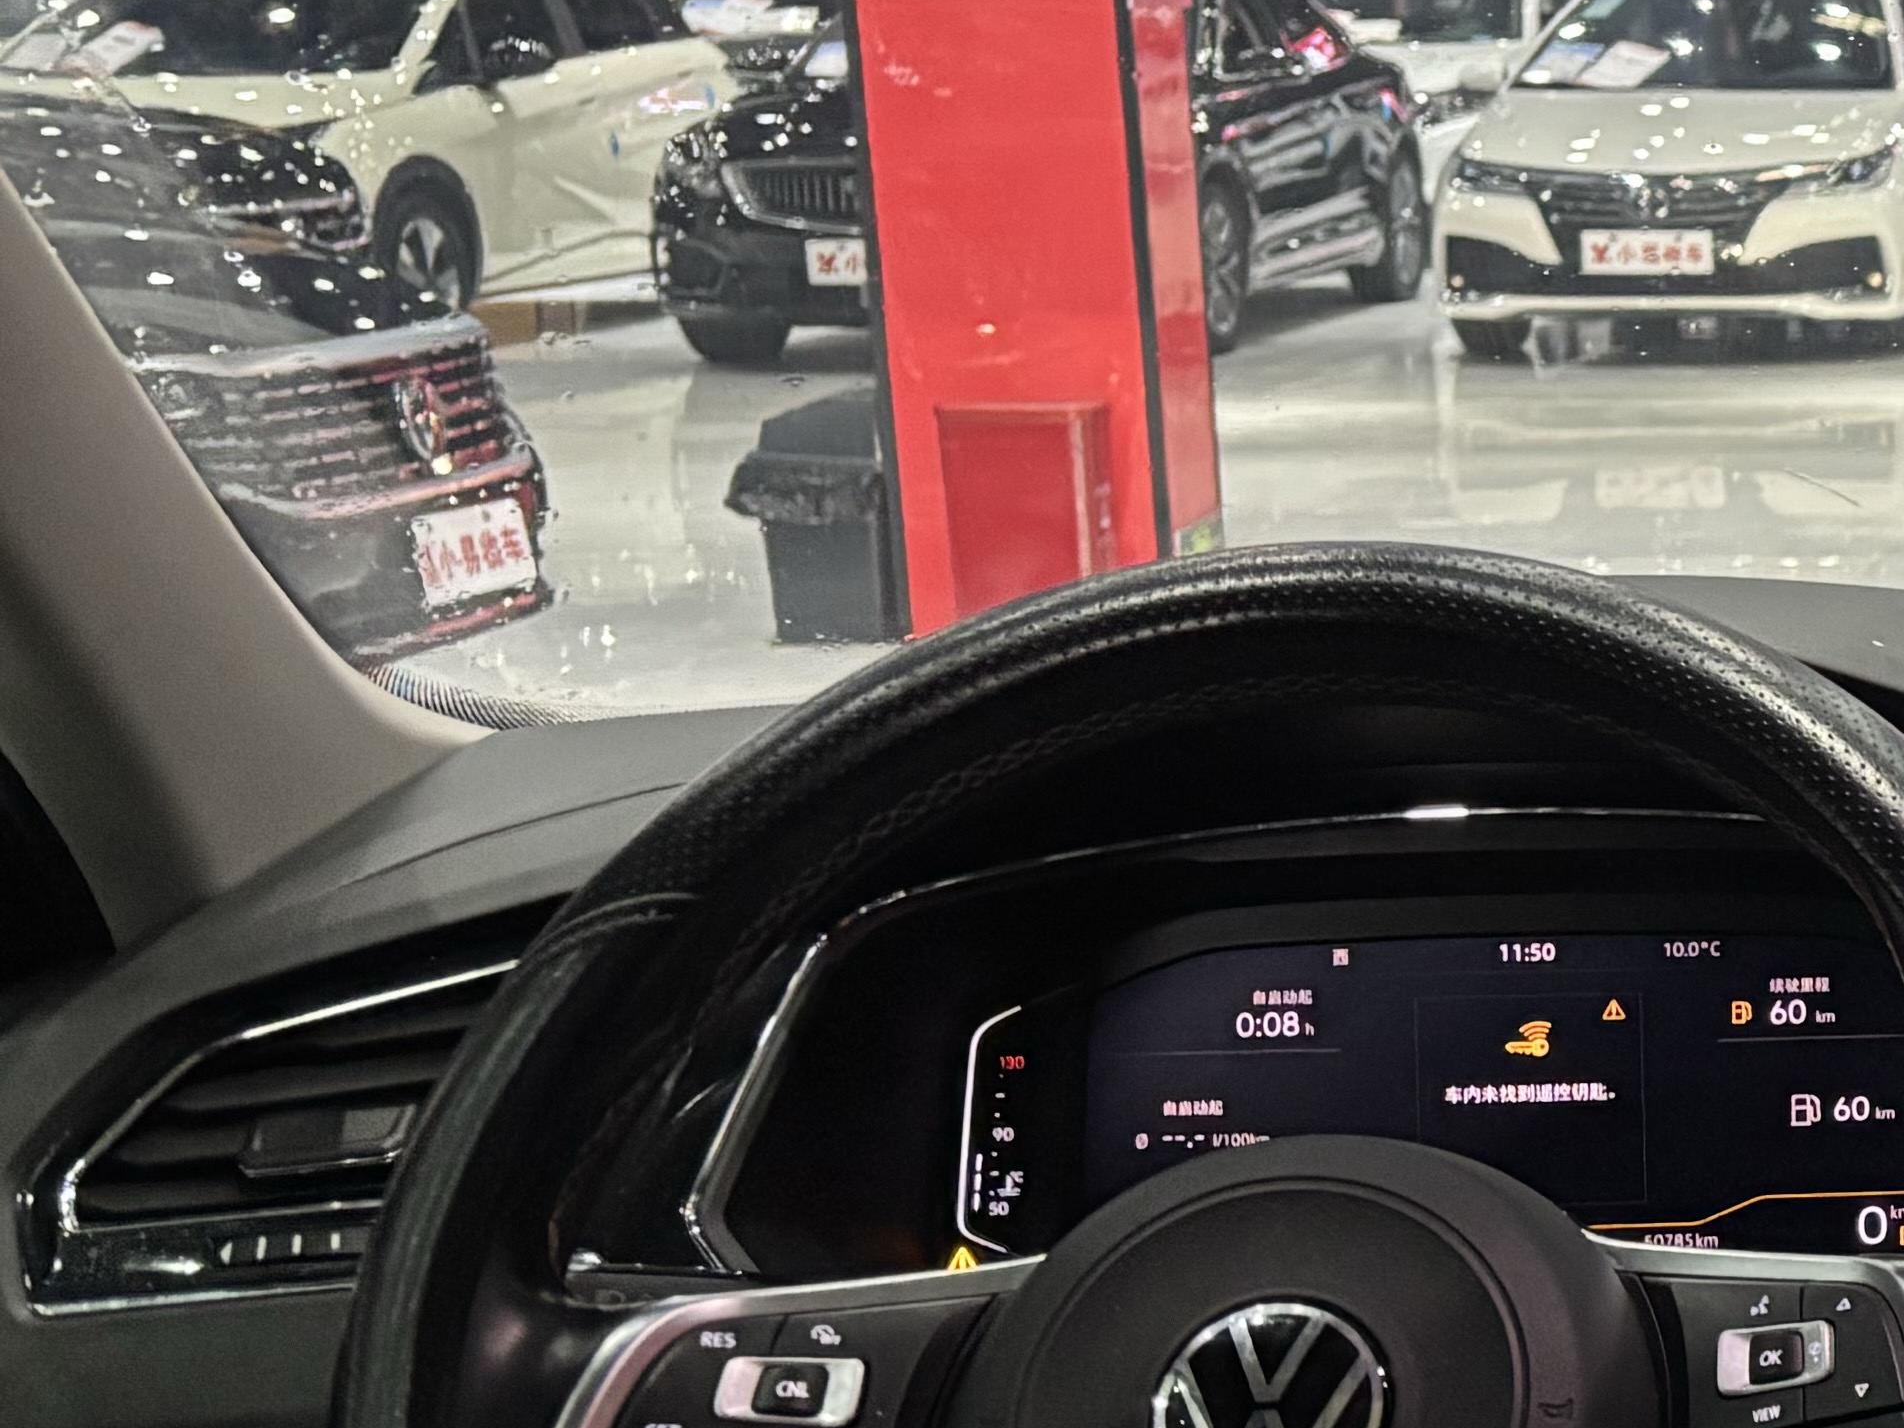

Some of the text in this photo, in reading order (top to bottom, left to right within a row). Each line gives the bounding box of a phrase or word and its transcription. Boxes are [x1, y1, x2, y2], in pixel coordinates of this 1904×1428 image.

[1499, 942, 1556, 963] 11:50
[1769, 998, 1836, 1026] 60 km
[1235, 1010, 1301, 1039] 0:08
[1833, 1095, 1896, 1122] 60 km
[992, 1126, 1015, 1142] 90
[988, 1201, 1010, 1216] 50
[1857, 1205, 1888, 1246] 0
[699, 1330, 737, 1349] RES
[1758, 1349, 1784, 1367] OK
[775, 1380, 810, 1399] CNL
[1752, 1404, 1781, 1423] VIEW
